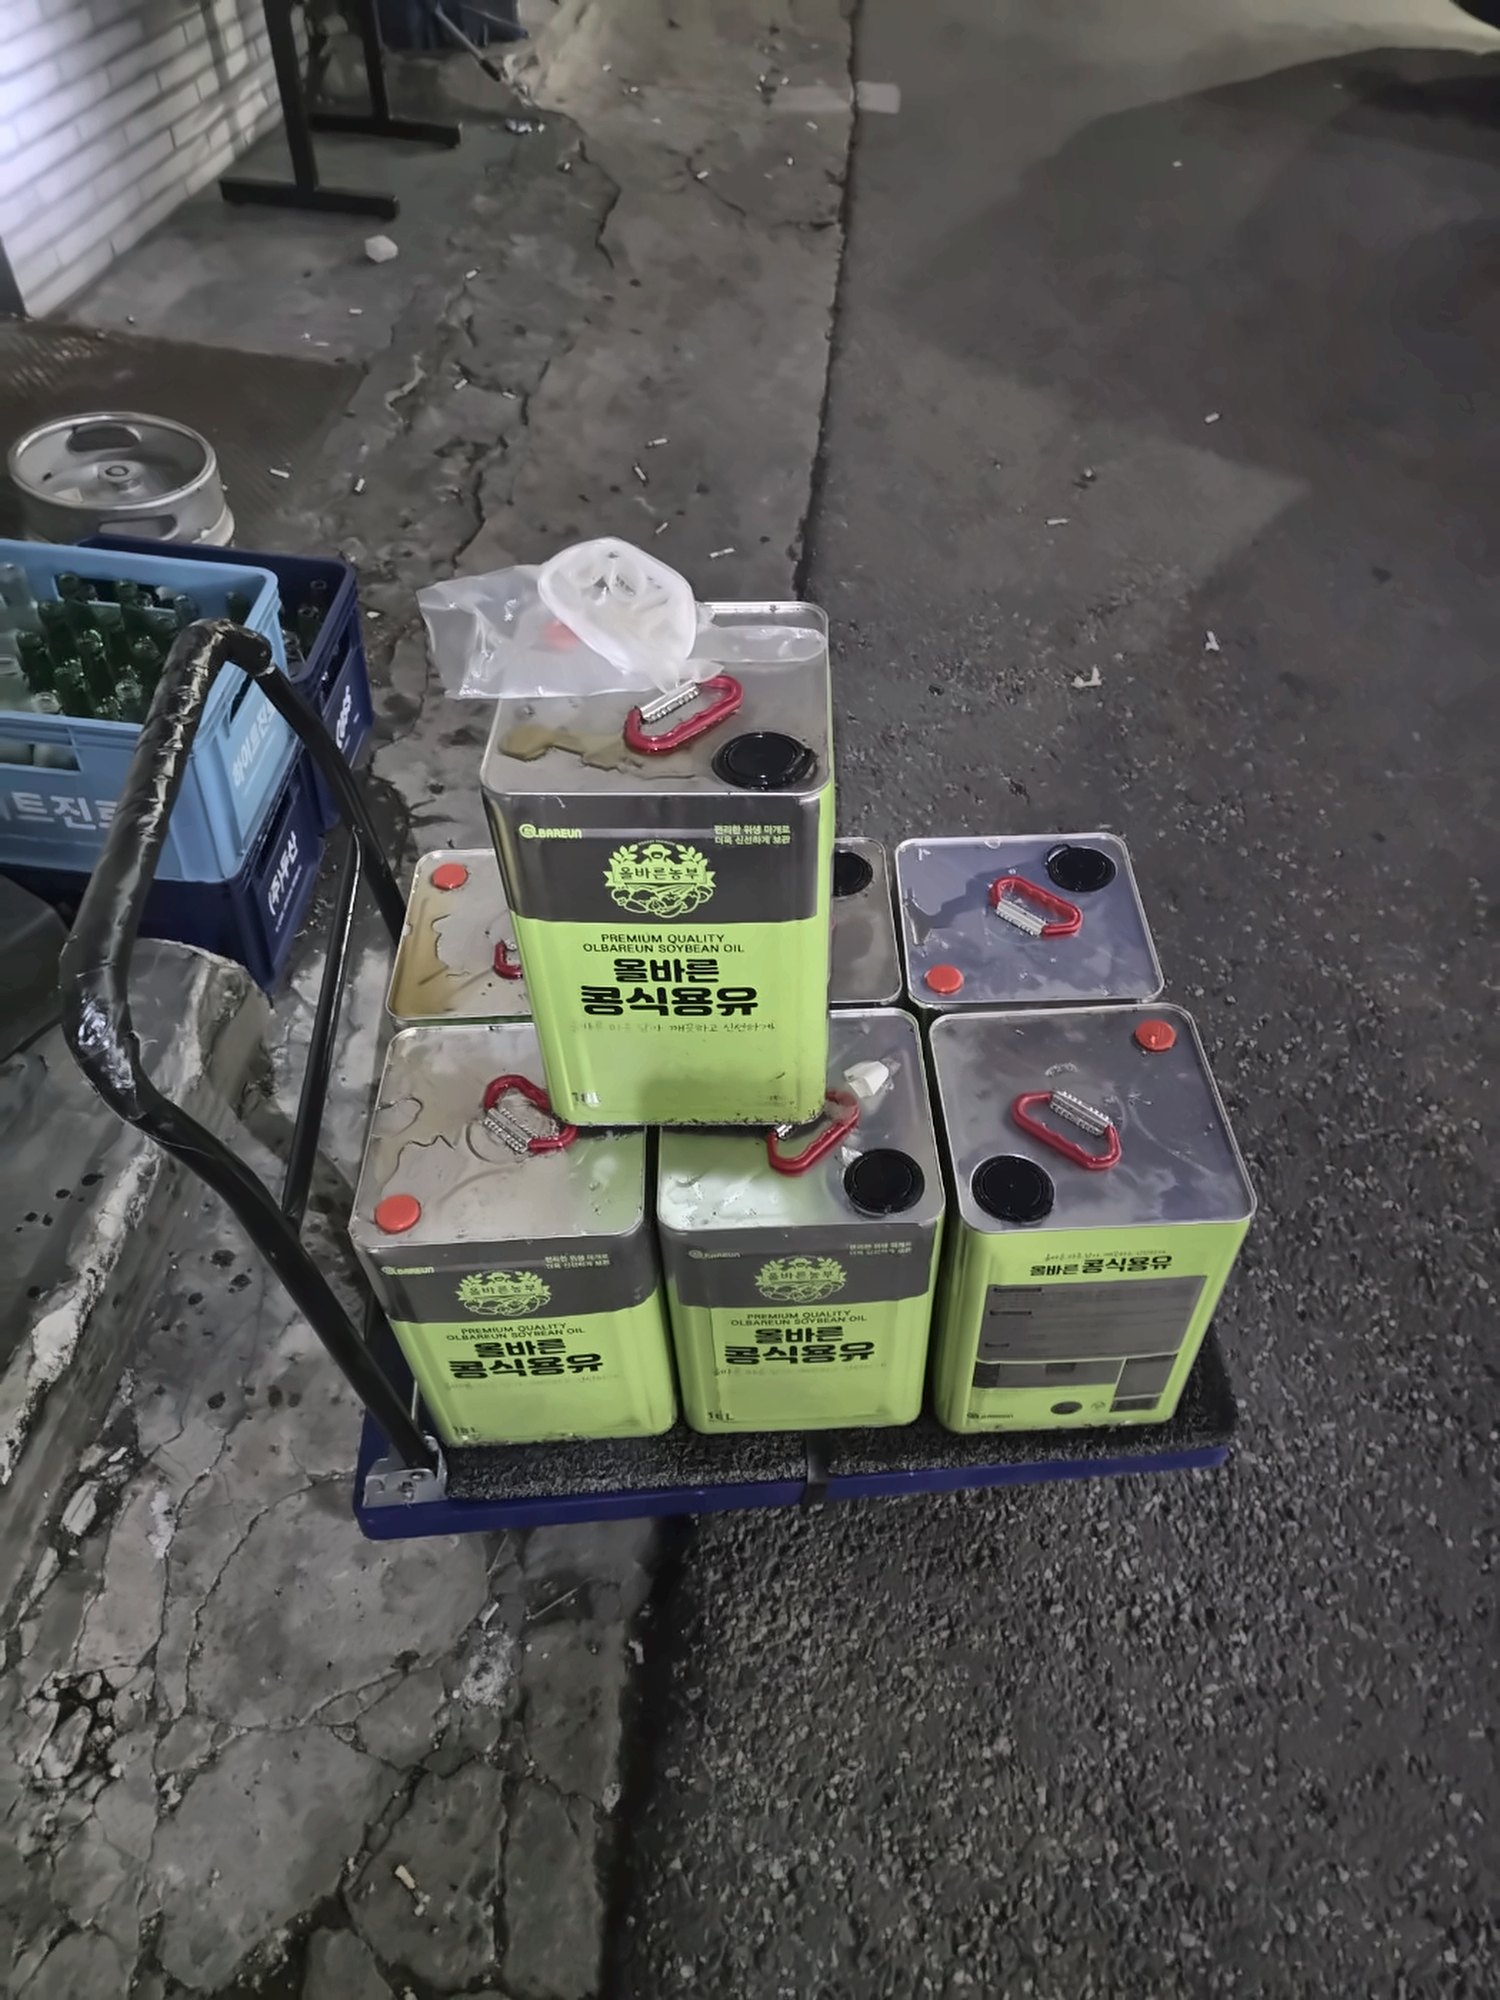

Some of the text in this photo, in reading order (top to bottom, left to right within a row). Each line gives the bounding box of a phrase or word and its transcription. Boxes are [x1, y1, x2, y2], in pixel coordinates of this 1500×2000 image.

[735, 835, 771, 845] 신선하게
[619, 866, 698, 880] 올바른농부
[601, 933, 725, 944] PREMIUM QUALITY
[582, 943, 745, 954] OLBAREUN SOYBEAN OIL
[613, 958, 720, 983] 올바른
[580, 985, 759, 1017] 콩식용유
[1081, 1255, 1173, 1274] 콩식용유
[747, 1310, 851, 1320] PREMIUM QUALITY
[461, 1323, 567, 1335] PREMIUM QUALITY
[755, 1325, 844, 1344] 올바른
[474, 1338, 567, 1358] 올바른
[724, 1341, 875, 1365] 콩식용유
[448, 1353, 604, 1379] 콩식용유
